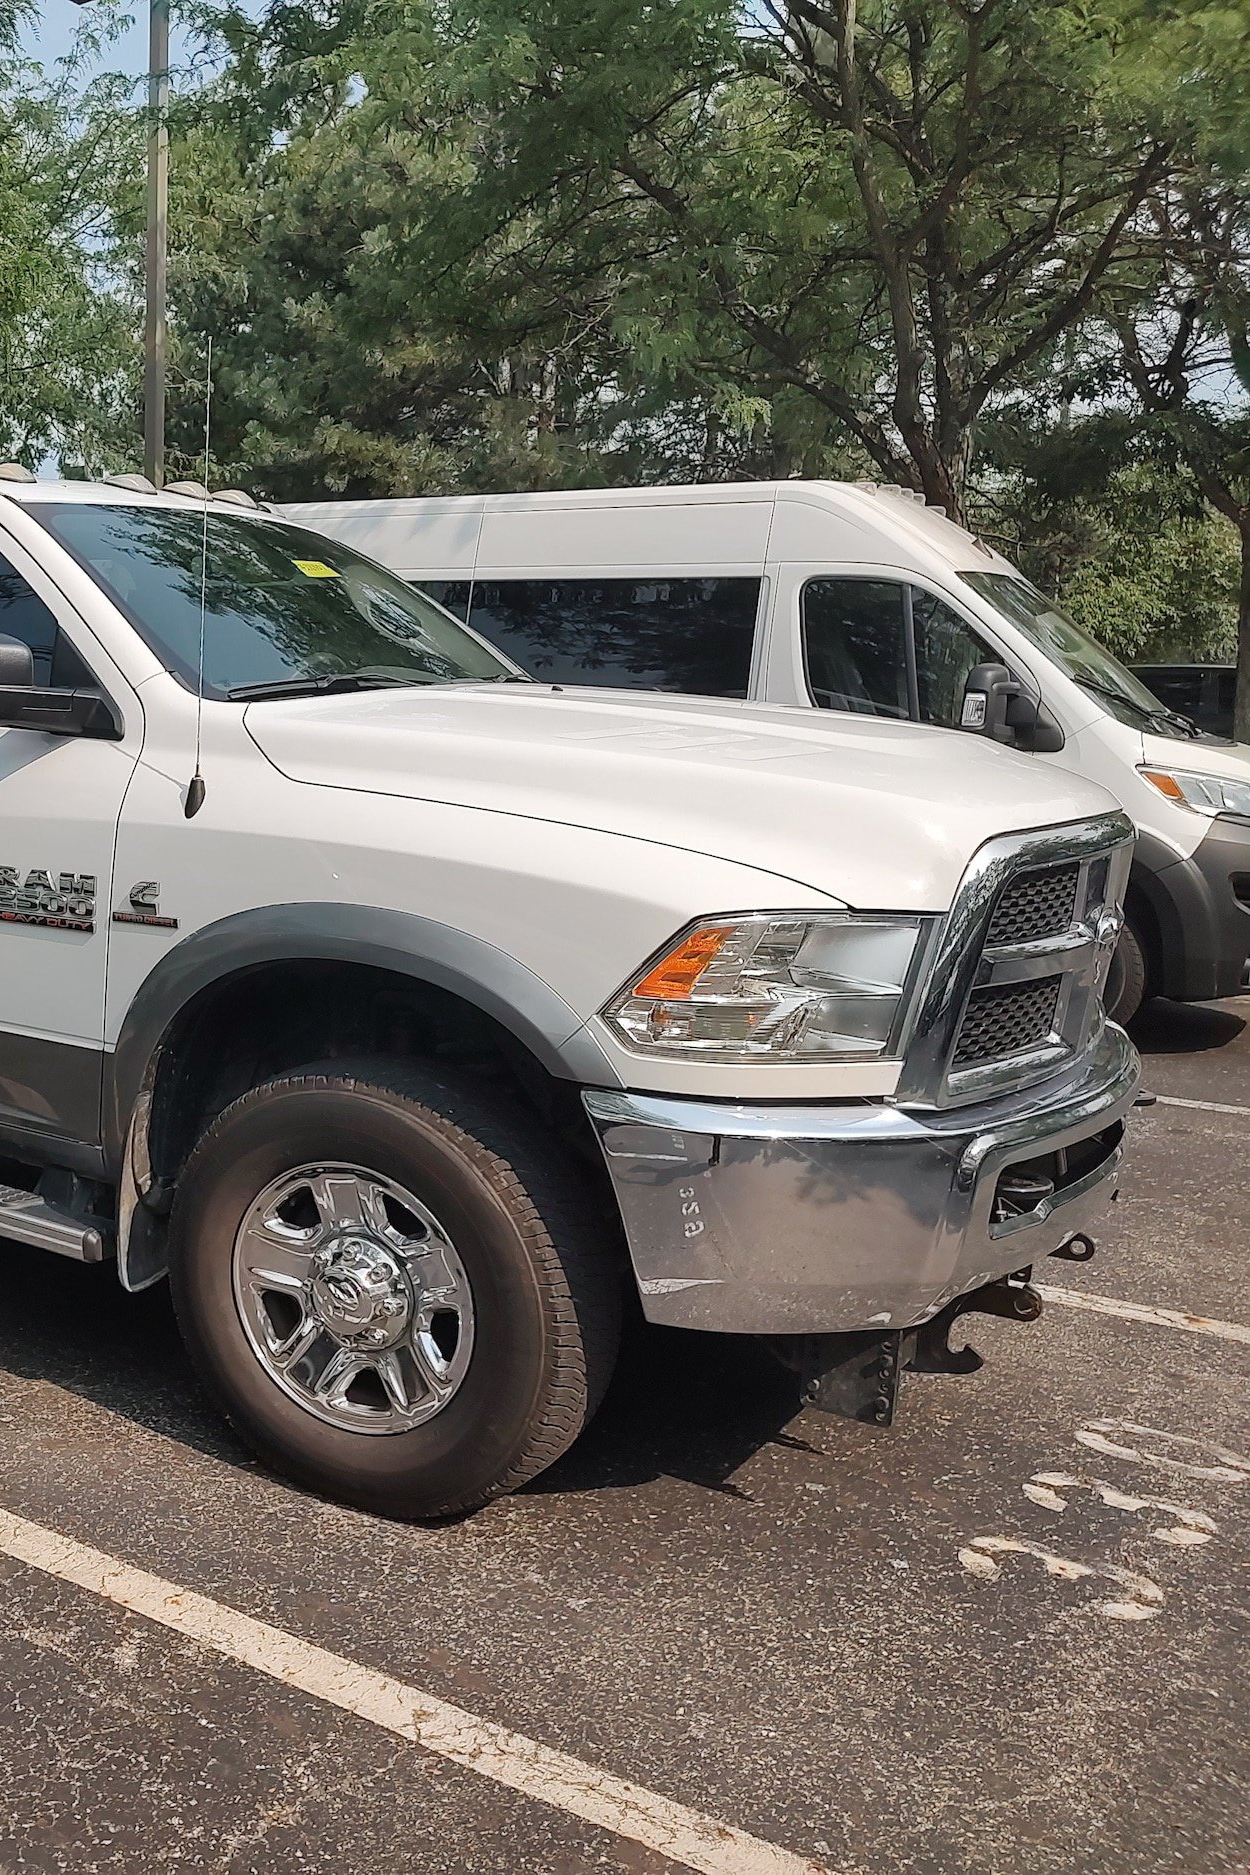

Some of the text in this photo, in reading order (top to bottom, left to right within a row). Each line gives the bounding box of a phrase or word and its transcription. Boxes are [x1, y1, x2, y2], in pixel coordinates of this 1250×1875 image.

[45, 917, 92, 930] DUTY
[114, 913, 174, 927] TURBO DIESEL
